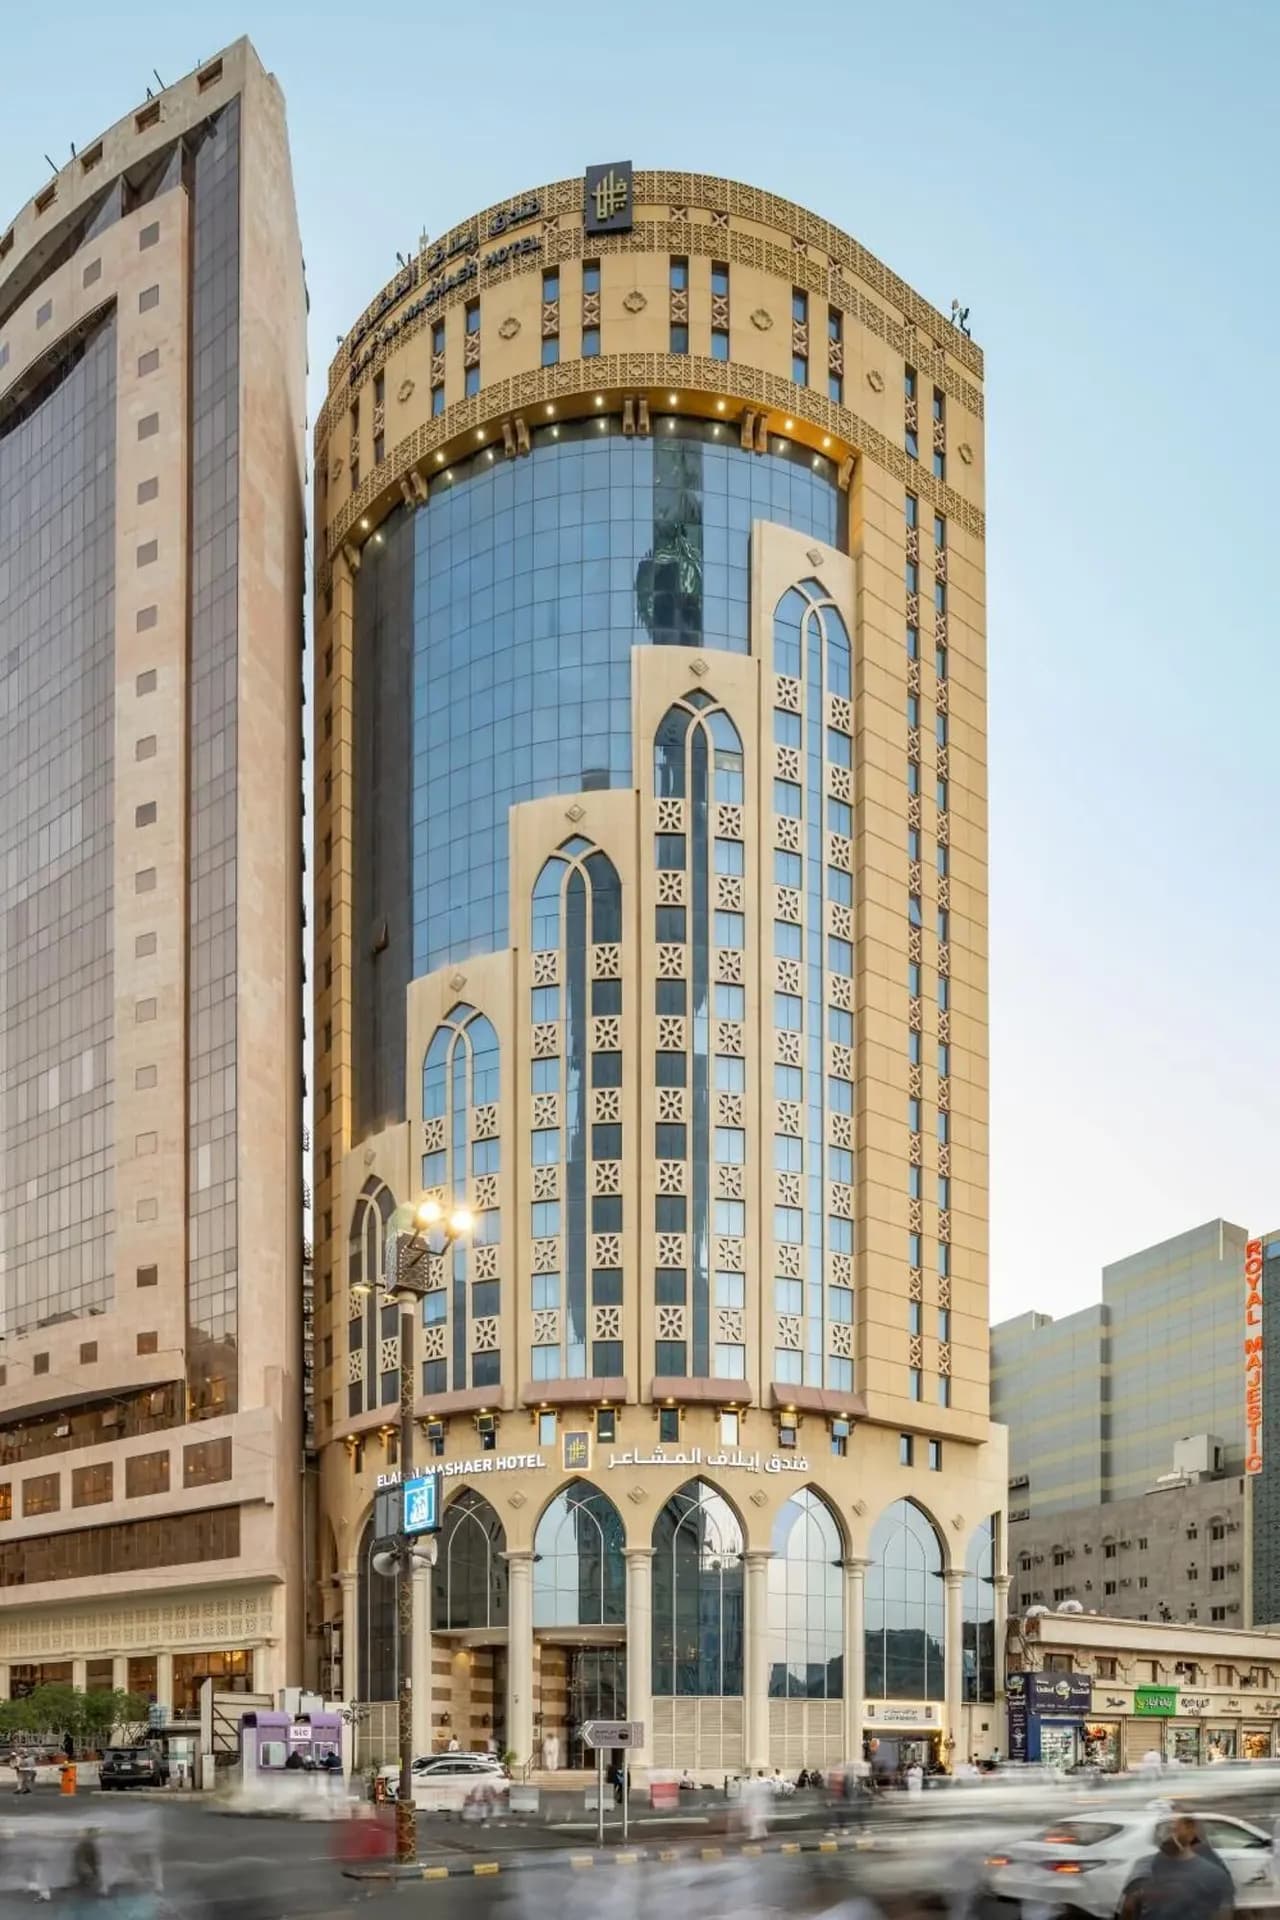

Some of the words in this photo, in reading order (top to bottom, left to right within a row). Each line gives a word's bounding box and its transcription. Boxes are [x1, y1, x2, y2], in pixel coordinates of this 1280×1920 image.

[484, 235, 542, 269] HOTEL
[1245, 1240, 1263, 1326] ROYAL
[1245, 1337, 1263, 1473] MAJESTIC
[425, 1458, 493, 1476] MASHAER
[496, 1454, 546, 1470] HOTEL
[608, 1446, 702, 1469] المشاعر
[707, 1450, 760, 1473] إيلاف
[764, 1453, 809, 1473] فندق
